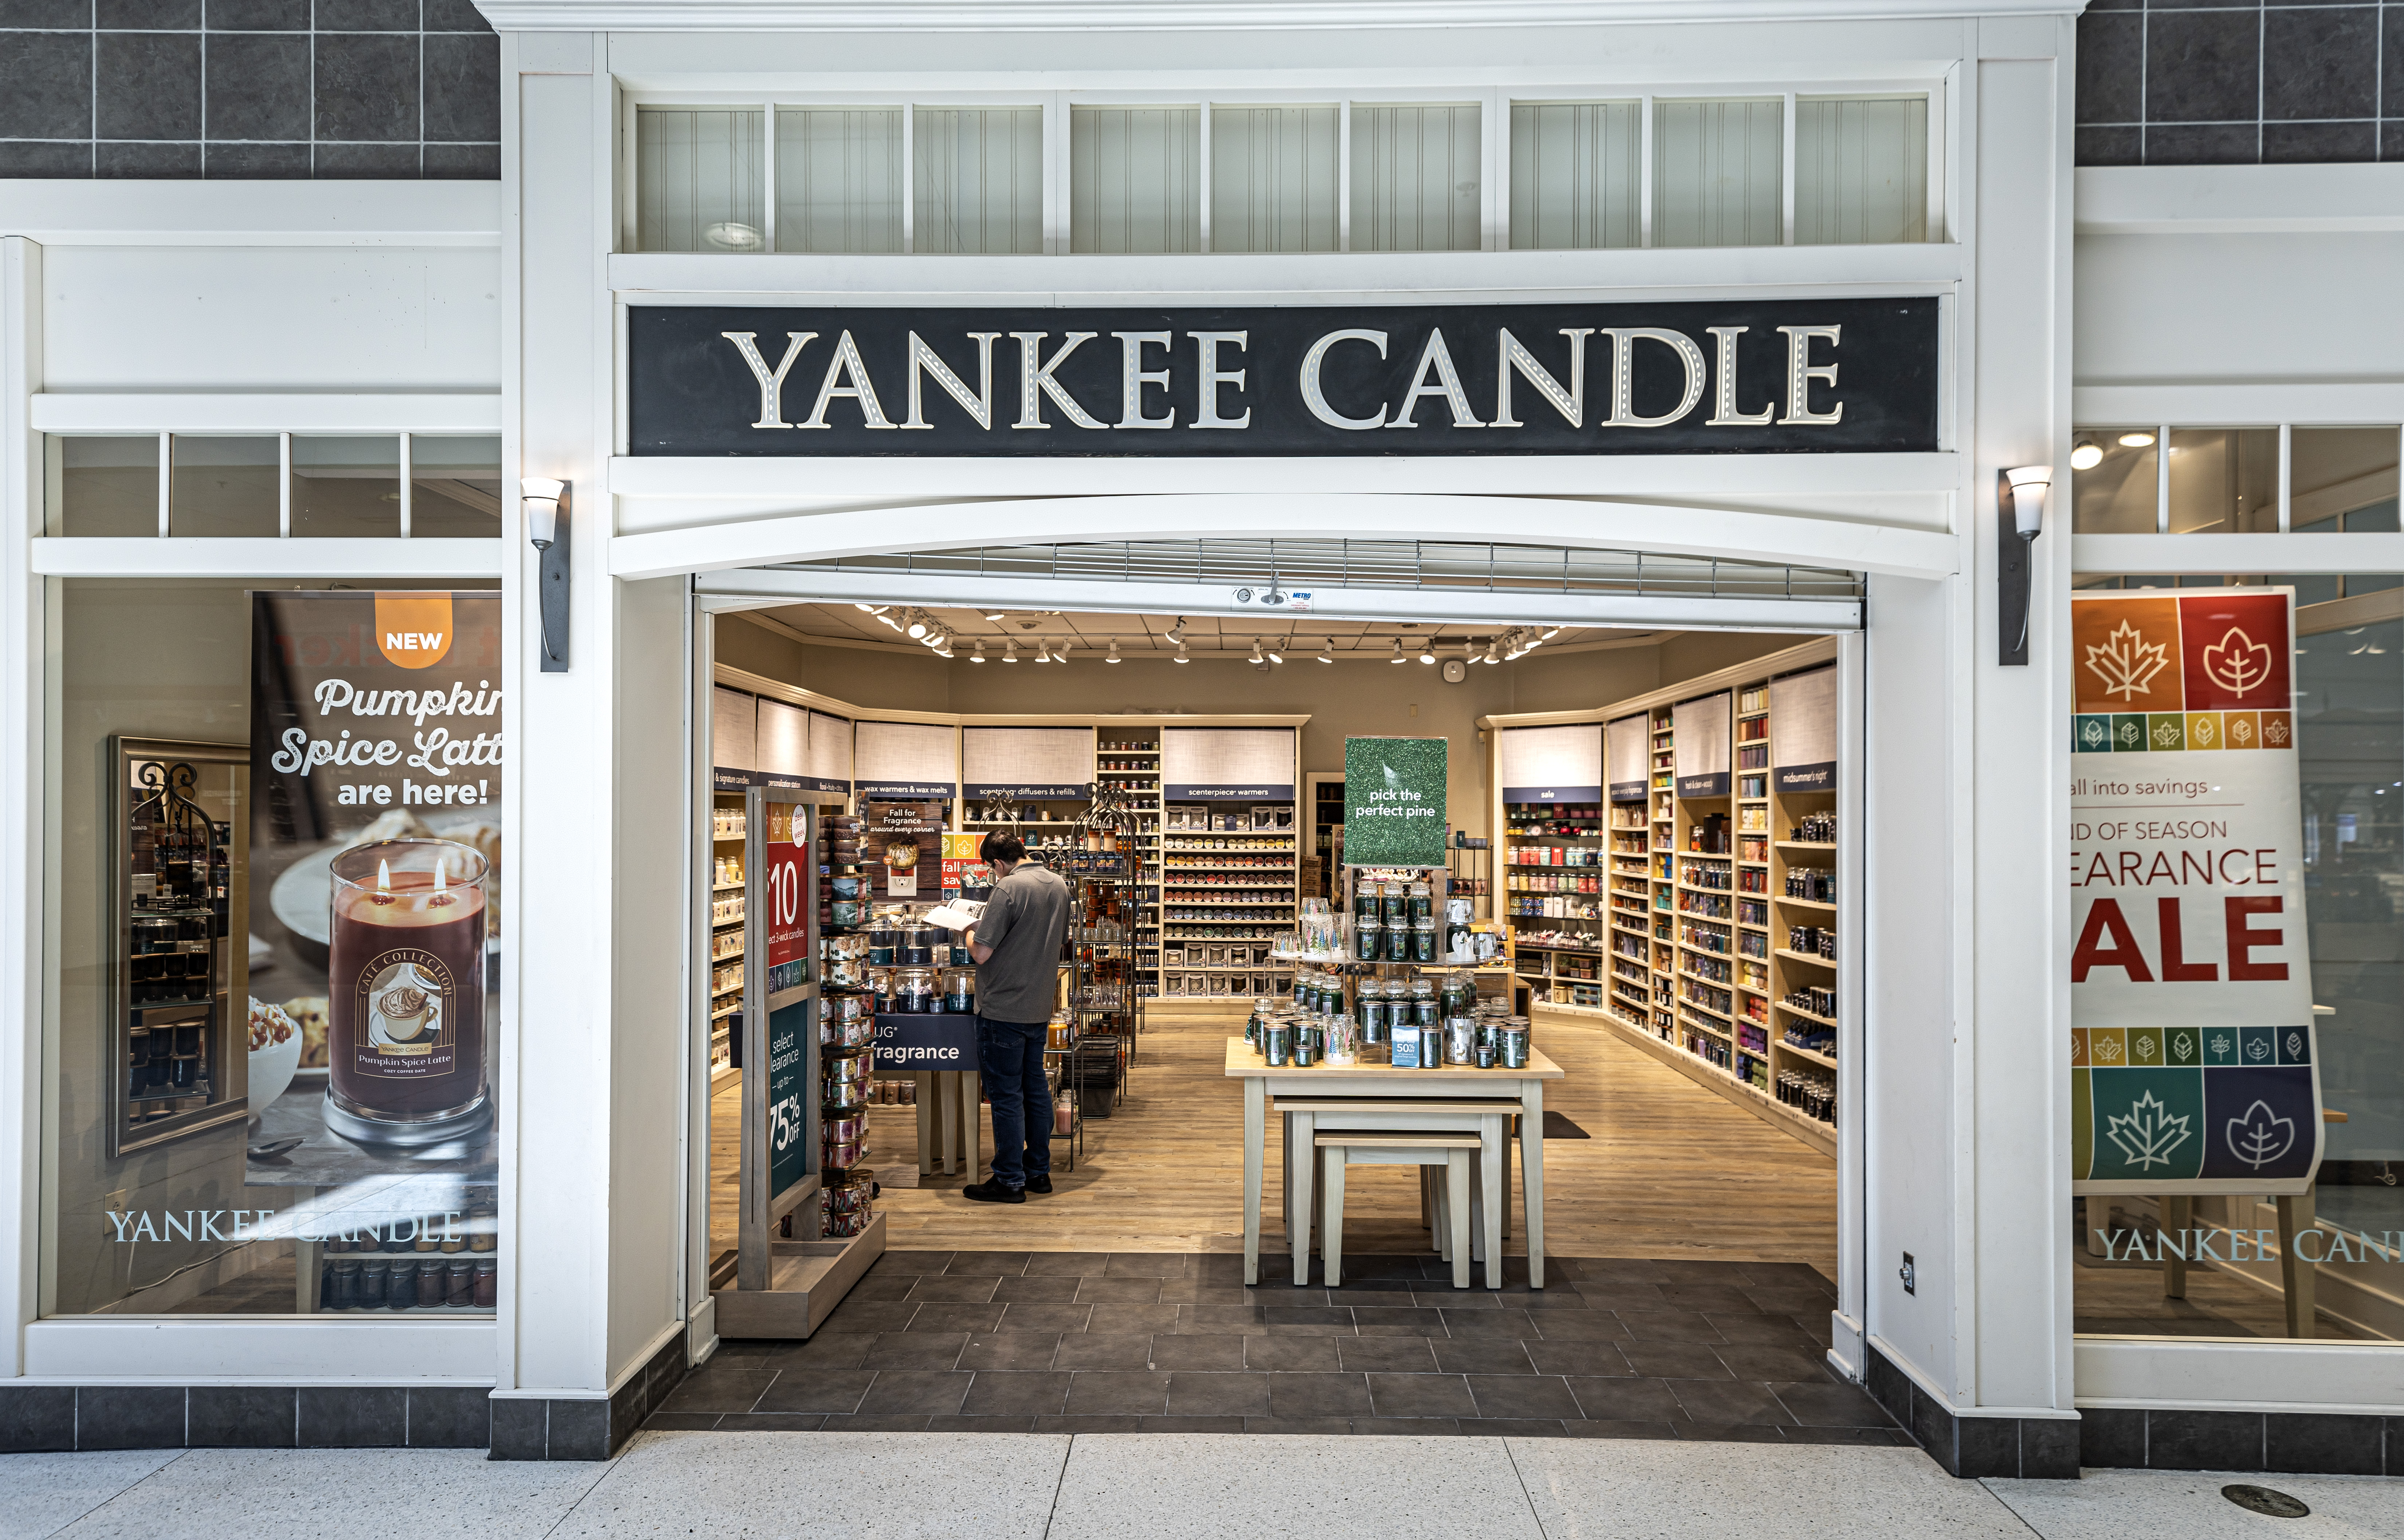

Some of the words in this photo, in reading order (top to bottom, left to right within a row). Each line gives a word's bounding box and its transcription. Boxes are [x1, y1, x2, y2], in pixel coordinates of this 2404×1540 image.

[721, 329, 1251, 431] YANKEE
[1300, 324, 1843, 430] CANDLE
[386, 633, 443, 649] NEW
[271, 727, 402, 776] Spice
[720, 773, 735, 785] signature
[736, 775, 749, 785] candles
[768, 779, 790, 788] personalization
[338, 784, 392, 805] are
[403, 778, 488, 804] here!
[1370, 788, 1397, 804] pick
[1400, 789, 1422, 800] the
[1541, 790, 1555, 798] sale
[2093, 779, 2129, 795] into
[2135, 778, 2208, 798] savings
[794, 809, 803, 822] deal
[904, 808, 916, 816] for
[1355, 804, 1403, 819] perfect
[1406, 805, 1435, 820] pine
[883, 817, 921, 826] Fragrance
[794, 828, 805, 840] week
[895, 826, 913, 834] every
[2098, 822, 2128, 840] OF
[2135, 820, 2227, 840] SEASON
[942, 861, 960, 872] fall
[767, 861, 797, 926] 10
[776, 930, 789, 943] 3-wick
[789, 927, 804, 940] candles
[360, 963, 381, 994] CAFÉ
[383, 952, 452, 995] COLLECTION
[773, 1031, 794, 1054] select
[1397, 1043, 1415, 1052] 50%
[871, 1042, 959, 1063] fragrance
[359, 1055, 400, 1067] Pumpkin
[401, 1058, 426, 1068] Spice
[428, 1056, 451, 1065] Latte
[777, 1081, 784, 1091] up
[784, 1076, 789, 1086] to
[789, 1121, 800, 1143] OFF
[105, 1210, 276, 1242] YANKEE
[291, 1211, 462, 1242] CANDLE
[2094, 1229, 2276, 1261] YANKEE
